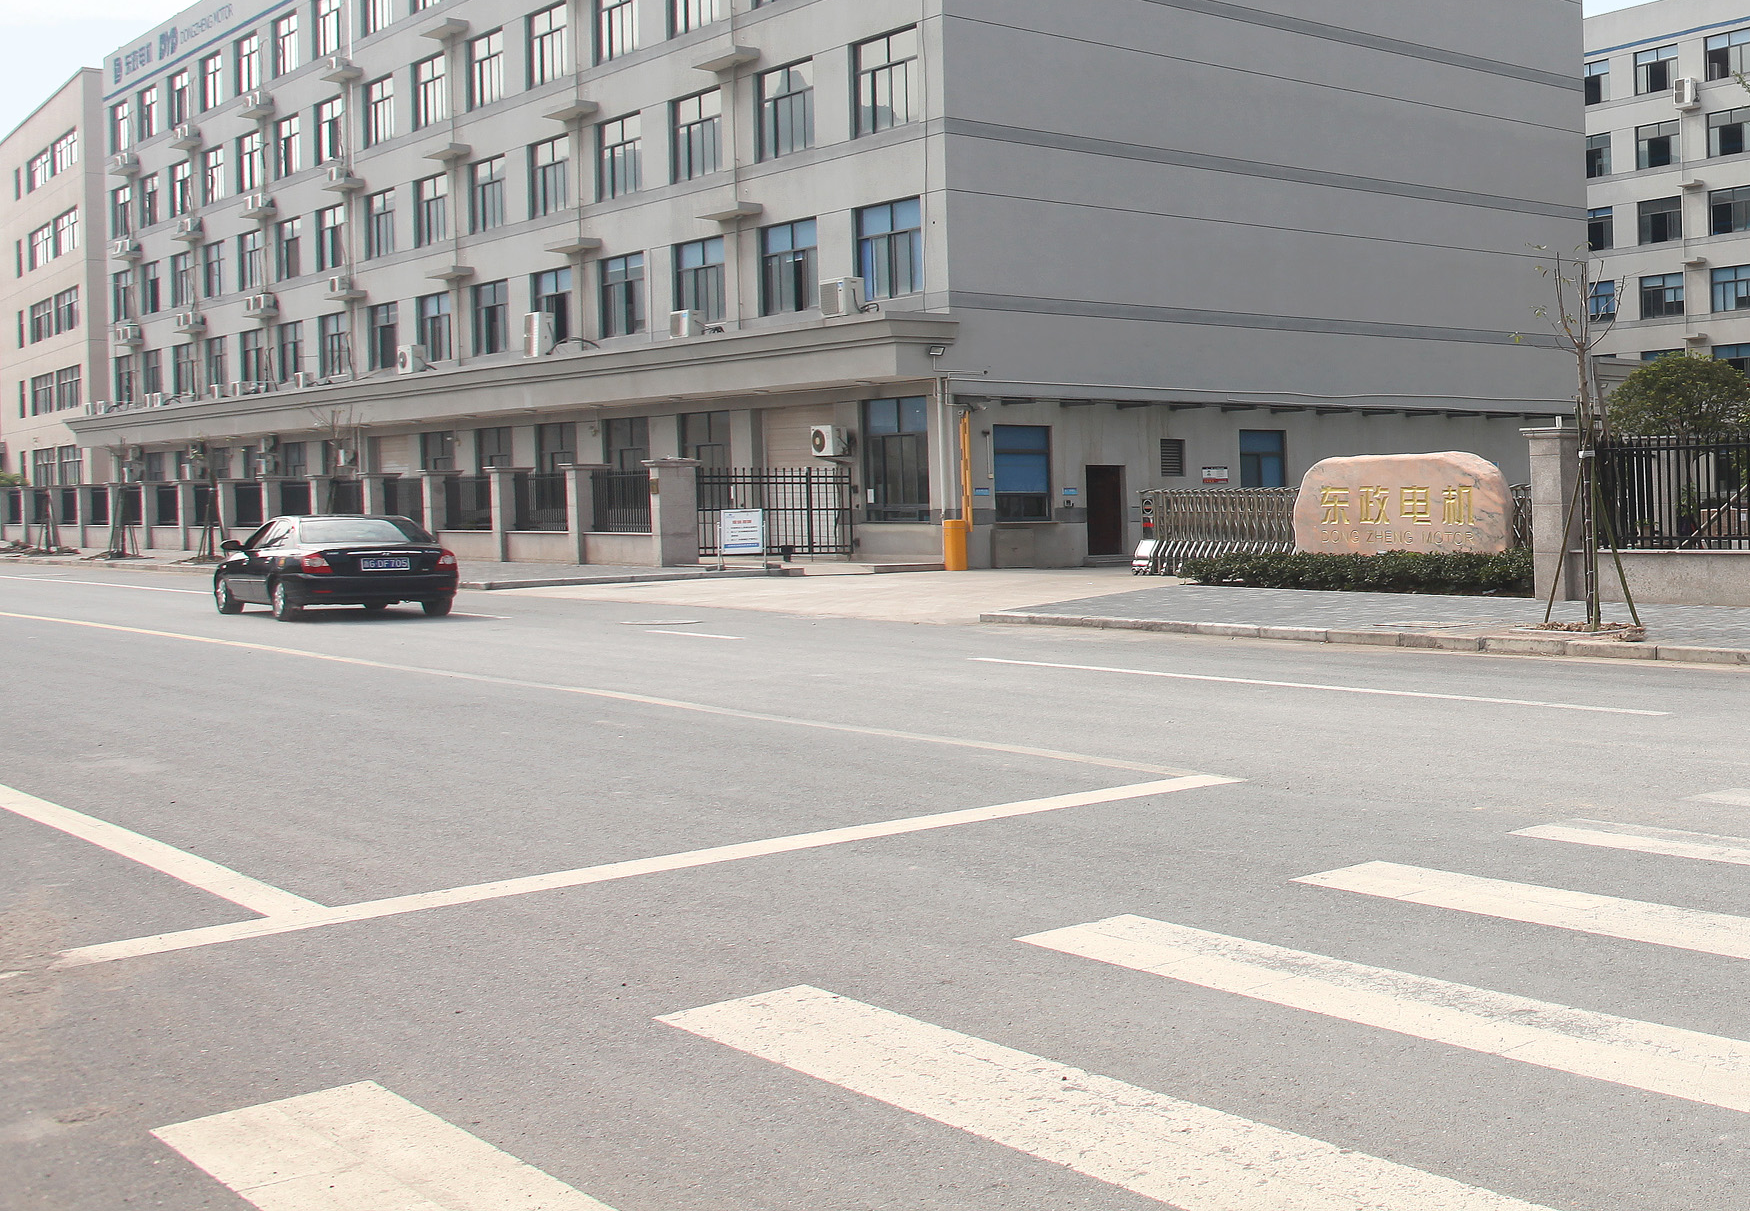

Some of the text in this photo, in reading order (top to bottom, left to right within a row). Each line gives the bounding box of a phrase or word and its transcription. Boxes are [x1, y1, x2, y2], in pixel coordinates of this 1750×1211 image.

[1321, 484, 1475, 526] 东政电机
[1322, 530, 1475, 545] DONG ZHENG MOTOR
